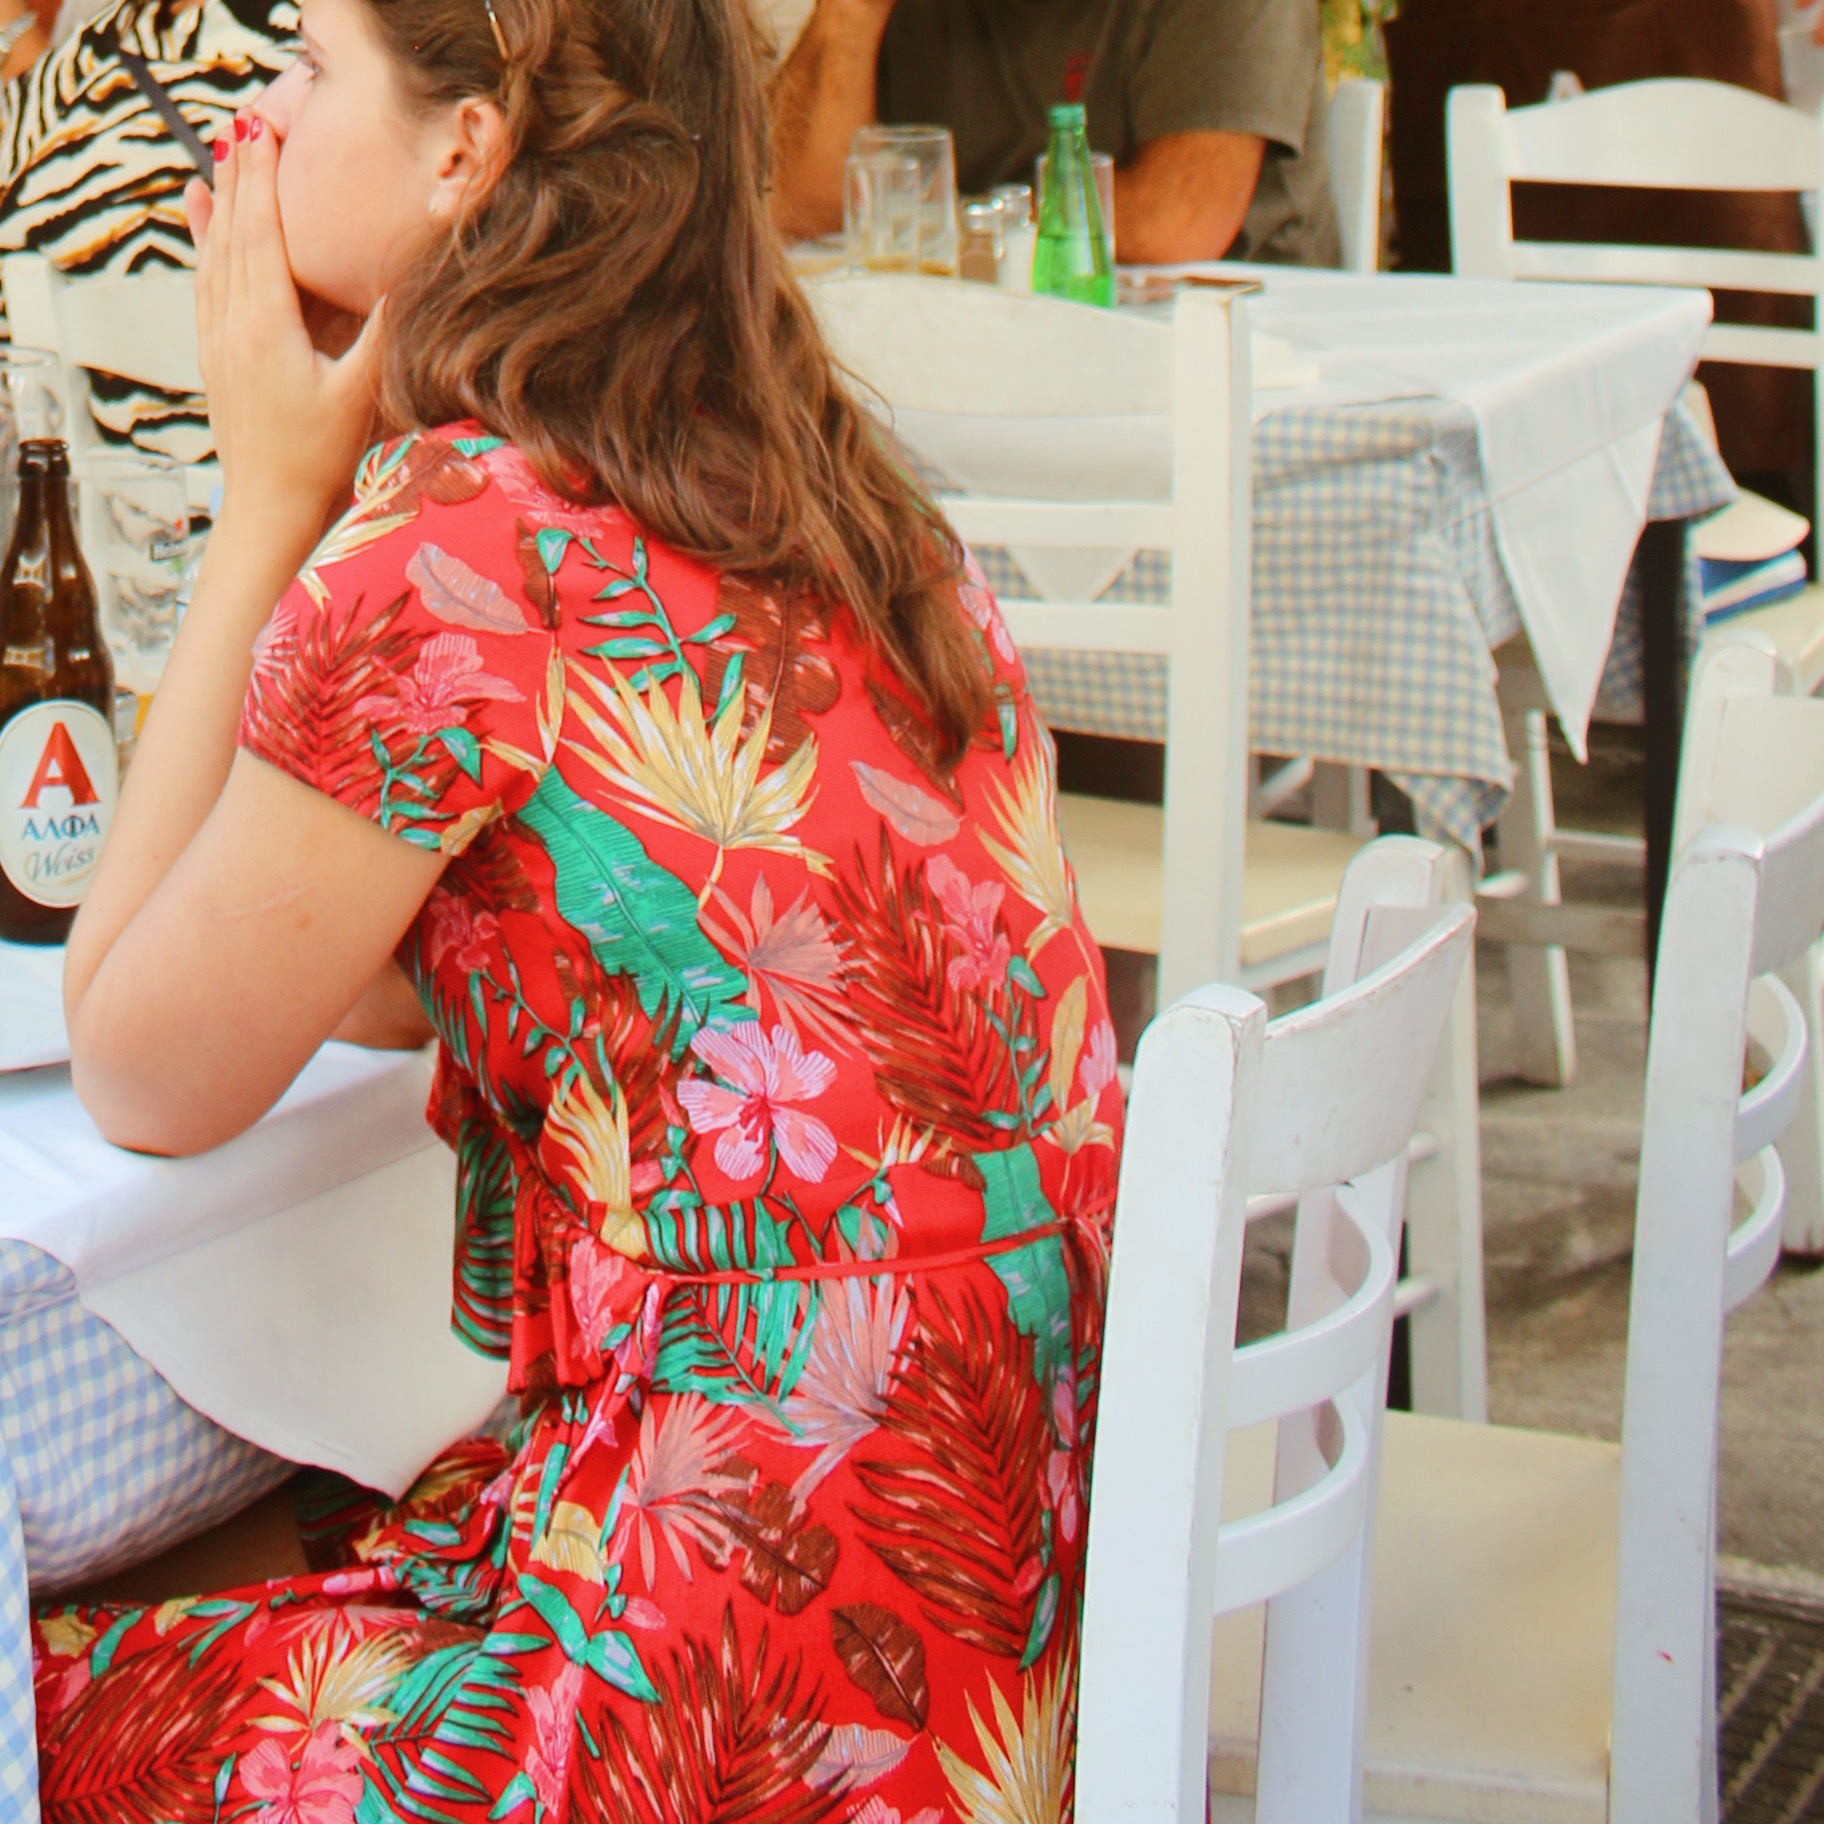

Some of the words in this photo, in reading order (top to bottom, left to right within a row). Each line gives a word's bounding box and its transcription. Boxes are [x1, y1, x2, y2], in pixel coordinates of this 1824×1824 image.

[18, 721, 101, 810] Α
[21, 813, 101, 841] ΑΛΦΑ
[25, 842, 95, 880] Weiss
